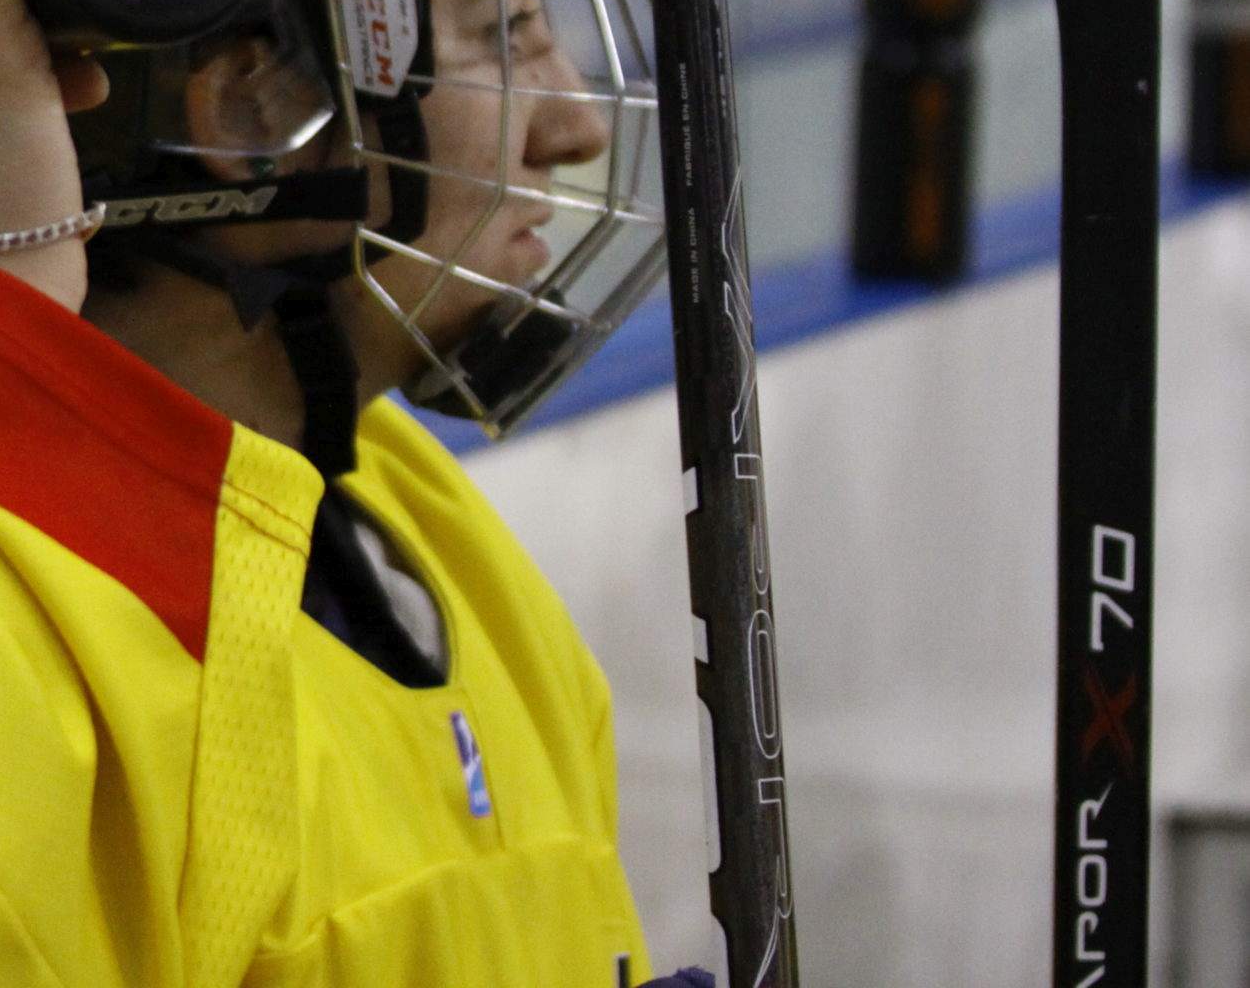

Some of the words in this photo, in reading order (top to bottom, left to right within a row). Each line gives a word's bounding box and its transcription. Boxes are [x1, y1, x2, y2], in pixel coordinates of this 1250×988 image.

[679, 62, 688, 100] CHINE
[681, 104, 691, 121] EN
[687, 207, 697, 246] CHINA
[689, 250, 698, 263] IN
